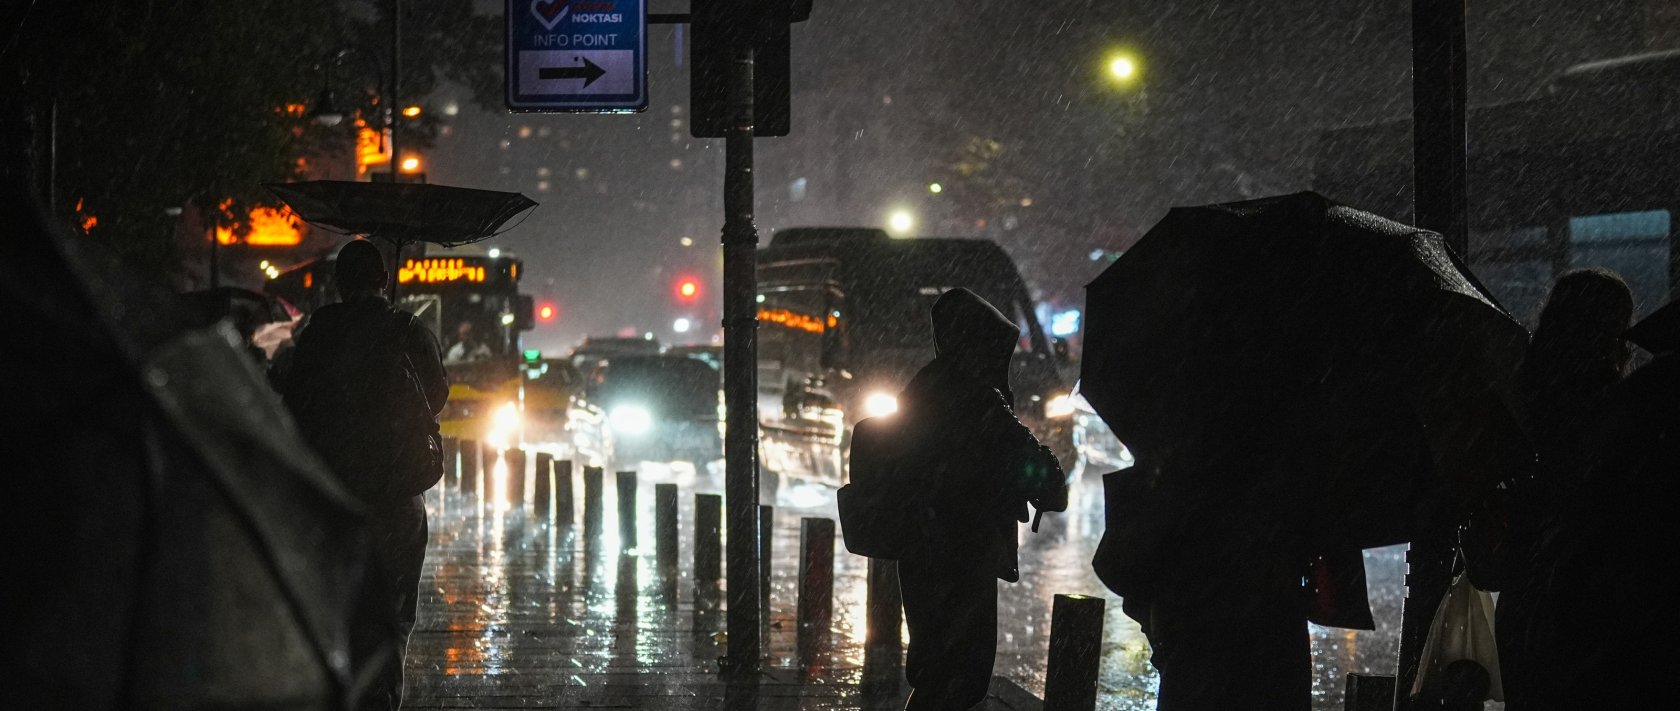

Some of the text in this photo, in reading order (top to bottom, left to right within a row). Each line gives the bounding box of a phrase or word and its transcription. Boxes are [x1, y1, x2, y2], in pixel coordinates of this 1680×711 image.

[572, 13, 623, 23] NOKTASI
[534, 34, 618, 46] INFO POINT
